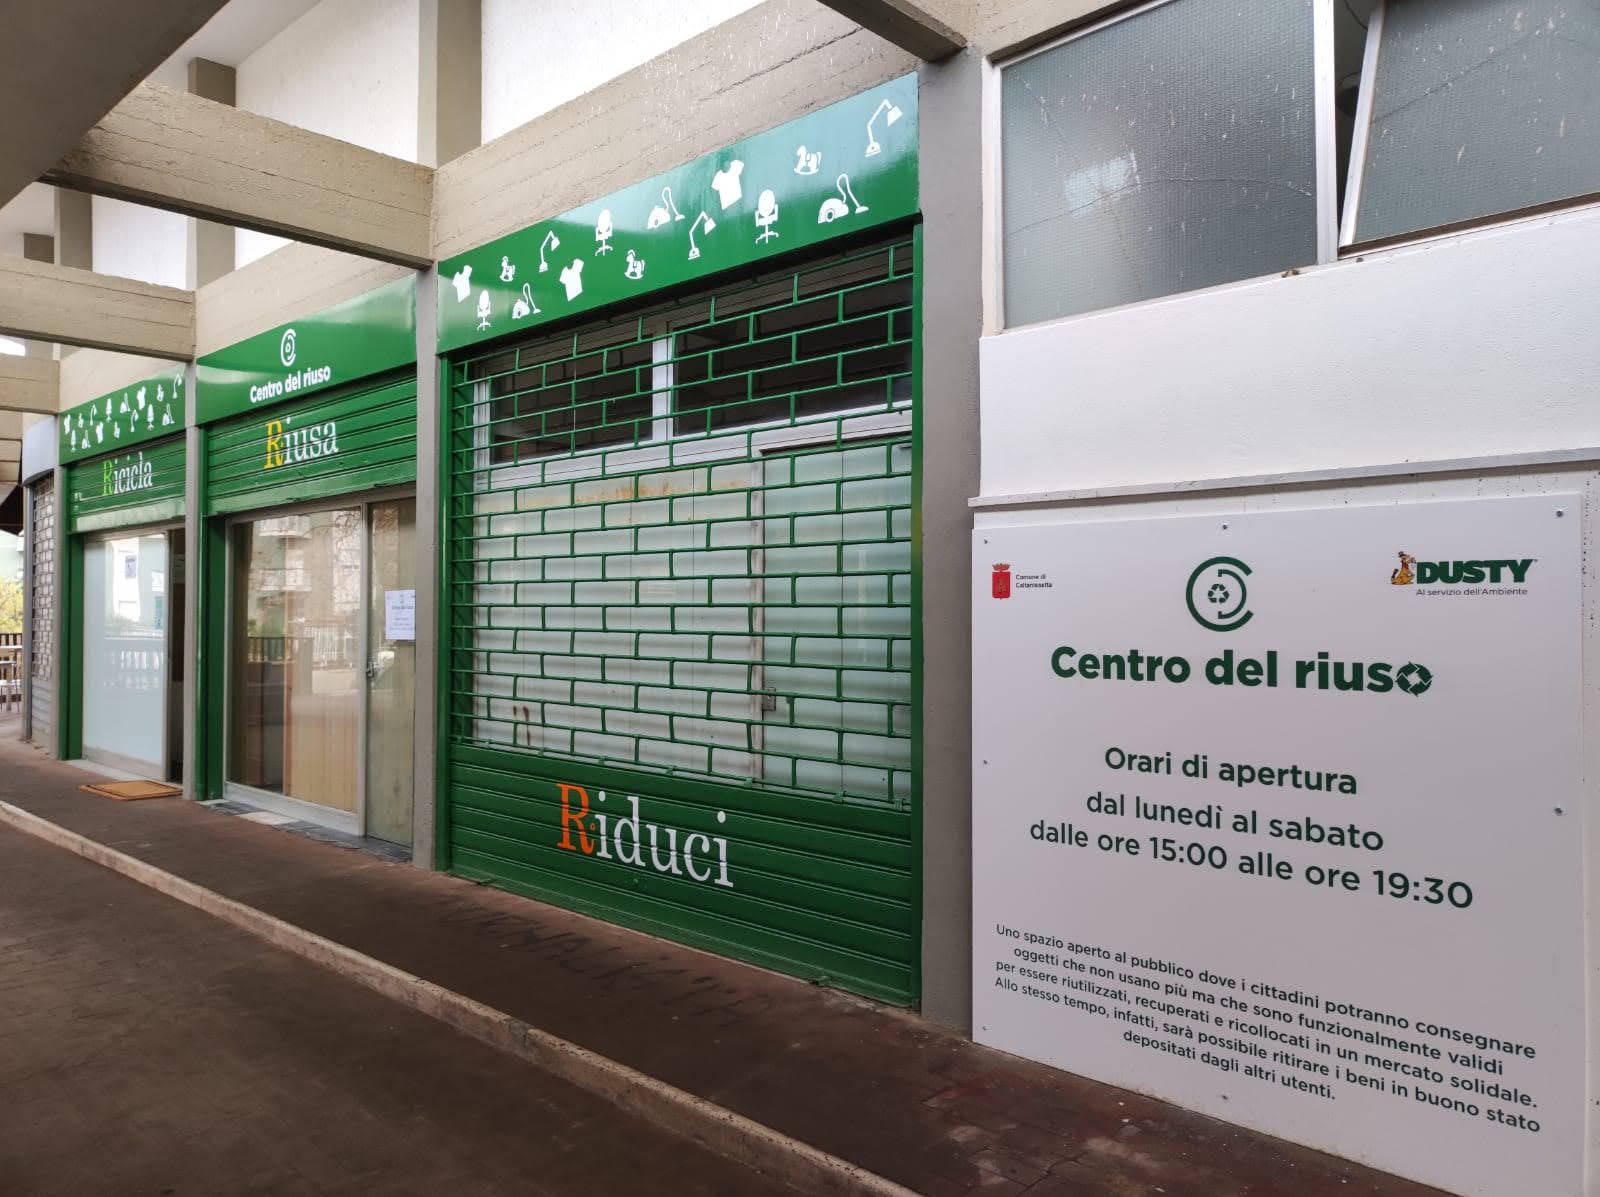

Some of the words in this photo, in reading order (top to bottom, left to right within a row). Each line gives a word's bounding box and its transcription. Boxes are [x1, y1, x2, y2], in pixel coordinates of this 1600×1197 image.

[250, 381, 283, 403] Centro
[285, 370, 302, 393] del
[303, 365, 331, 388] riuso
[263, 416, 339, 469] Riusa
[102, 451, 153, 496] Ricicla
[1416, 588, 1425, 596] Al
[1427, 588, 1462, 596] servizio
[1464, 587, 1528, 596] dell'Ambiente
[1417, 558, 1534, 584] DUSTY
[1051, 645, 1191, 684] Centro
[1205, 649, 1278, 688] del
[1104, 747, 1172, 775] Orari
[1181, 754, 1208, 779] di
[1218, 762, 1357, 795] apertura
[555, 783, 734, 888] Riduci
[1086, 791, 1125, 817] dal
[1135, 795, 1223, 830] lunedì
[1232, 810, 1257, 835] al
[1269, 816, 1384, 851] sabato
[1030, 819, 1089, 848] dalle
[1097, 834, 1140, 856] ore
[1149, 836, 1227, 870] 15:00
[1238, 851, 1293, 880] alle
[1305, 865, 1360, 891] ore
[1372, 870, 1473, 909] 19:30
[996, 924, 1020, 939] Uno
[1024, 932, 1064, 949] spazio
[1067, 942, 1111, 960] aperto
[1114, 951, 1126, 964] al
[1131, 956, 1194, 979] pubblico
[1198, 970, 1237, 989] dove
[1241, 978, 1245, 992] i
[1250, 982, 1319, 1009] cittadini
[1325, 1000, 1409, 1029] potranno
[1415, 1022, 1536, 1059] consegnare
[1014, 948, 1059, 966] oggetti
[1062, 958, 1086, 973] che
[1089, 966, 1115, 980] non
[1119, 973, 1160, 990] usano
[1165, 983, 1187, 998] più
[1192, 990, 1215, 1005] ma
[1220, 996, 1248, 1012] che
[1253, 1005, 1293, 1023] sono
[1298, 1013, 1441, 1060] funzionalmente
[1448, 1052, 1503, 1076] validi
[995, 977, 1018, 992] Allo
[1022, 985, 1060, 1003] stesso
[1063, 994, 1109, 1019] tempo,
[1114, 1006, 1158, 1032] infatti,
[1163, 1023, 1193, 1039] sarà
[1198, 1032, 1267, 1059] possibile
[1273, 1050, 1330, 1076] ritirare
[1335, 1065, 1340, 1079] i
[1346, 1068, 1385, 1092] beni
[1392, 1080, 1408, 1098] in
[1415, 1086, 1479, 1116] buono
[1486, 1109, 1540, 1132] stato
[996, 961, 1016, 973] per
[1019, 967, 1058, 984] essere
[1062, 976, 1131, 1005] riutilizzati,
[1135, 996, 1209, 1023] recuperati
[1214, 1016, 1224, 1027] e
[1228, 1018, 1310, 1050] ricollocati
[1316, 1038, 1331, 1055] in
[1337, 1047, 1358, 1062] un
[1364, 1054, 1444, 1083] mercato
[1450, 1076, 1537, 1108] solidale.
[1123, 1030, 1196, 1060] depositati
[1200, 1051, 1239, 1072] dagli
[1244, 1064, 1276, 1083] altri
[1281, 1075, 1335, 1100] utenti.
